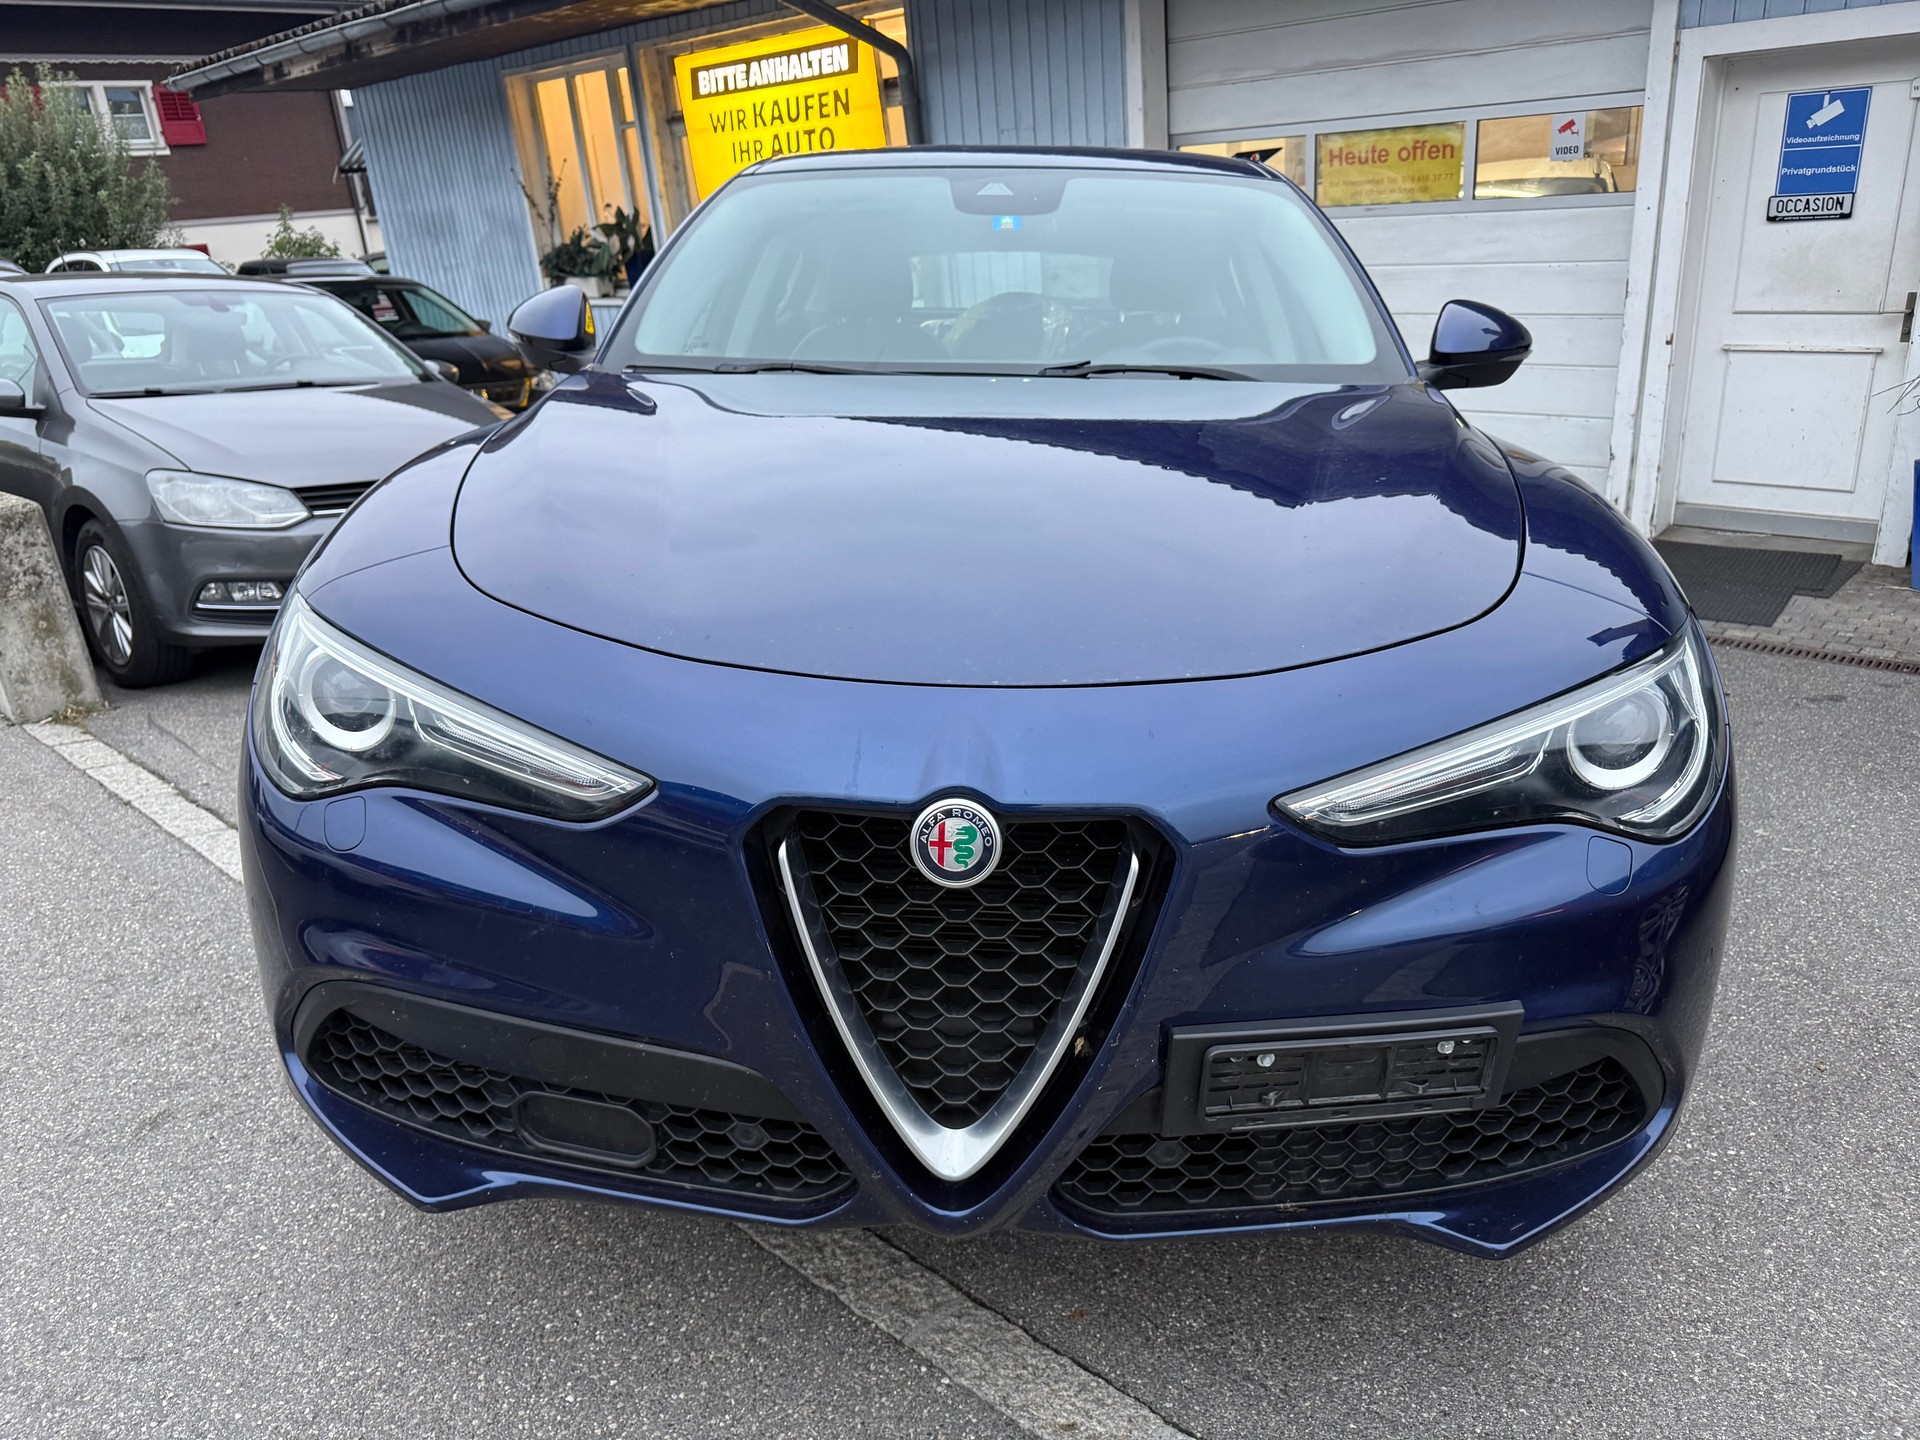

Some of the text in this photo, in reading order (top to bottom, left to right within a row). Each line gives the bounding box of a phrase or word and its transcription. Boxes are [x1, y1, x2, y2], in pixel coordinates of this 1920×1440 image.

[697, 43, 849, 96] BITTE ANHALTEN
[709, 88, 850, 134] WIR KAUFEN
[732, 126, 836, 164] IHR AUTO
[1555, 145, 1579, 155] VIDEO
[1786, 133, 1860, 144] Videoaufzeichnung
[1329, 139, 1455, 167] Heute offen
[1781, 164, 1857, 176] Privatgrundstück
[1776, 196, 1845, 214] OCCASION
[920, 808, 992, 847] ALFA ROMEO
